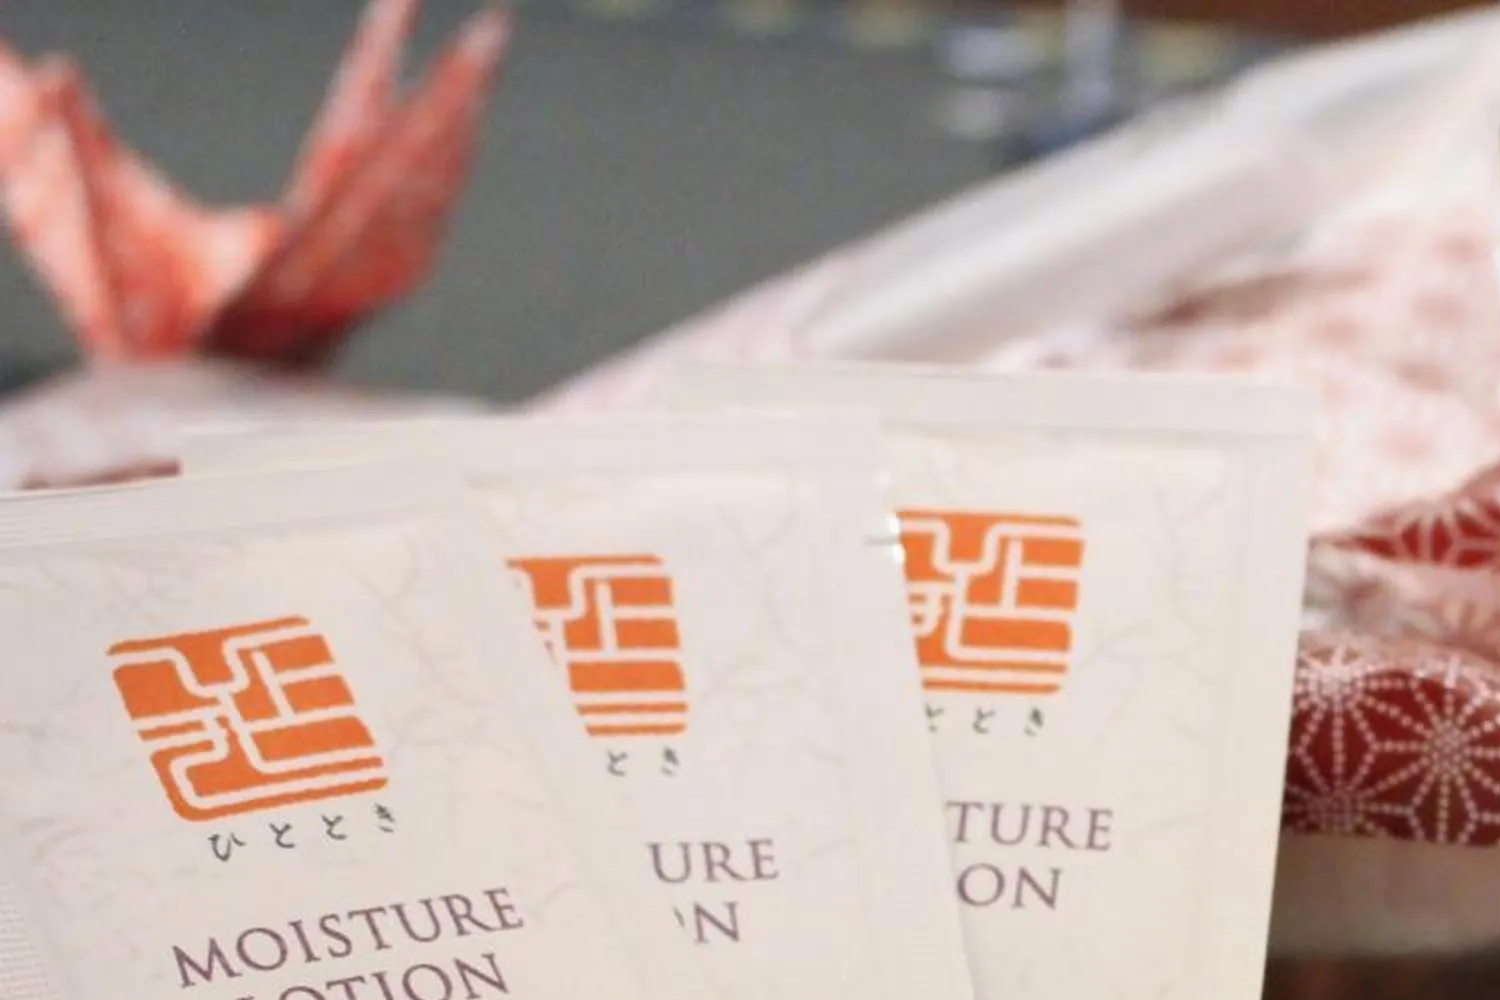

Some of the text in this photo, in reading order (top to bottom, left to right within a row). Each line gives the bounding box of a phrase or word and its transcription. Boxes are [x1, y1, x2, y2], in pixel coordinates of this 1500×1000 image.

[207, 804, 395, 862] ひととき
[945, 799, 1114, 851] TURE
[646, 838, 779, 883] URE
[956, 863, 1063, 910] ON
[172, 887, 525, 989] MOISTURE
[672, 901, 740, 944] N
